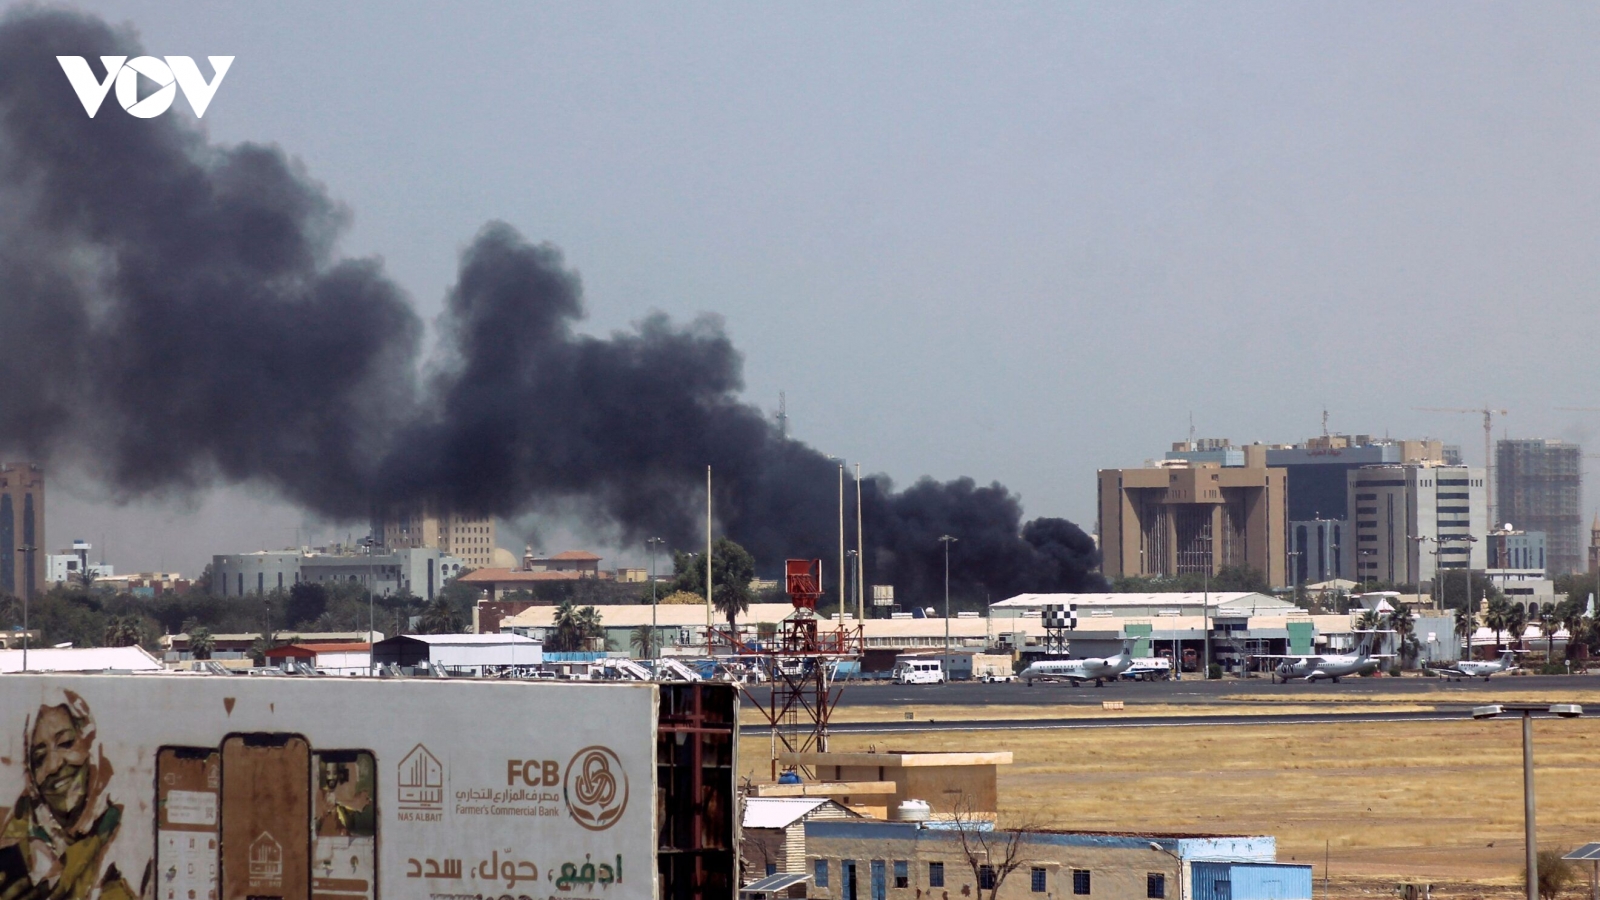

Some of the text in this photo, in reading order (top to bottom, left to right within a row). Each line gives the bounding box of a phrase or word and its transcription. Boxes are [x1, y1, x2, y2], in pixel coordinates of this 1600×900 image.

[507, 759, 560, 787] FCB
[456, 787, 559, 804] مصرف المزارع التجاري
[398, 812, 443, 822] NAS ALBAIT
[455, 804, 560, 817] Farmer's Commercial Bank
[406, 857, 463, 879] سدد
